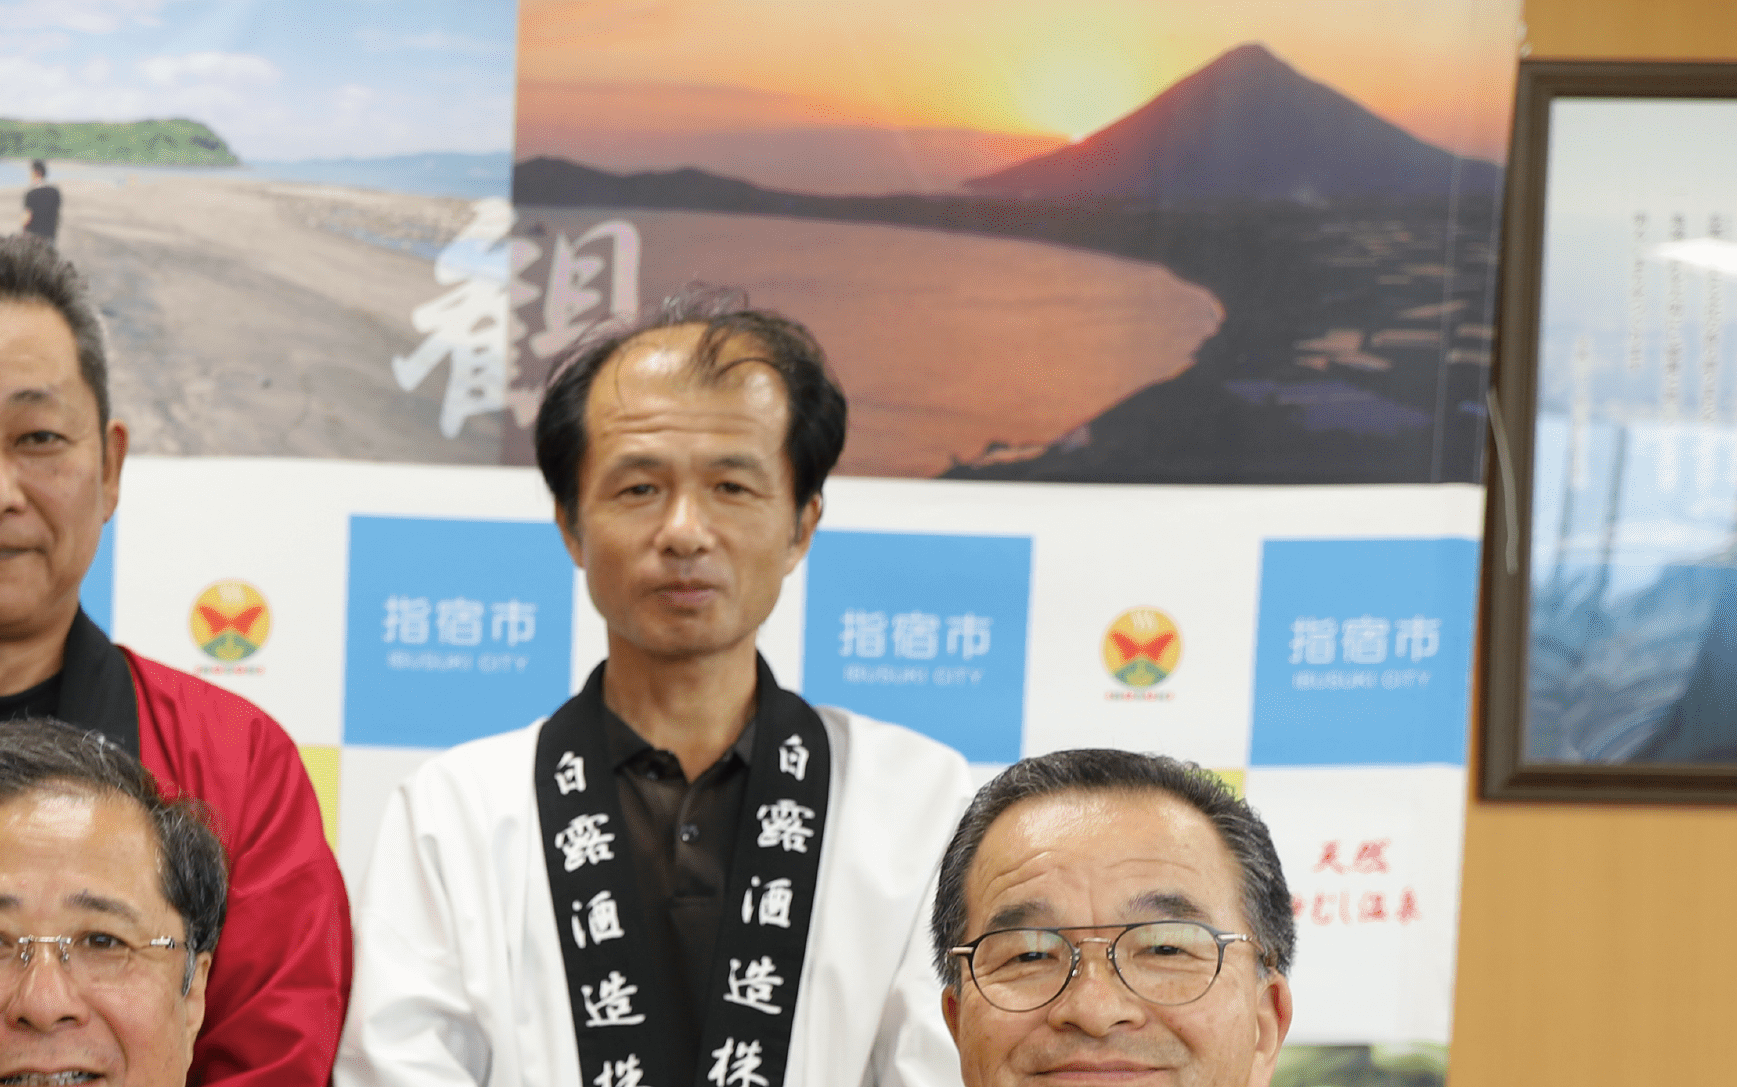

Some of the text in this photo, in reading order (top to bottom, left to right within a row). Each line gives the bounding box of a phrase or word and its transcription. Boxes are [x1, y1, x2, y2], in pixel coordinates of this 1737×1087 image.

[382, 595, 537, 646] 指宿市
[839, 609, 993, 661] 指宿市
[1289, 615, 1441, 664] 指宿市
